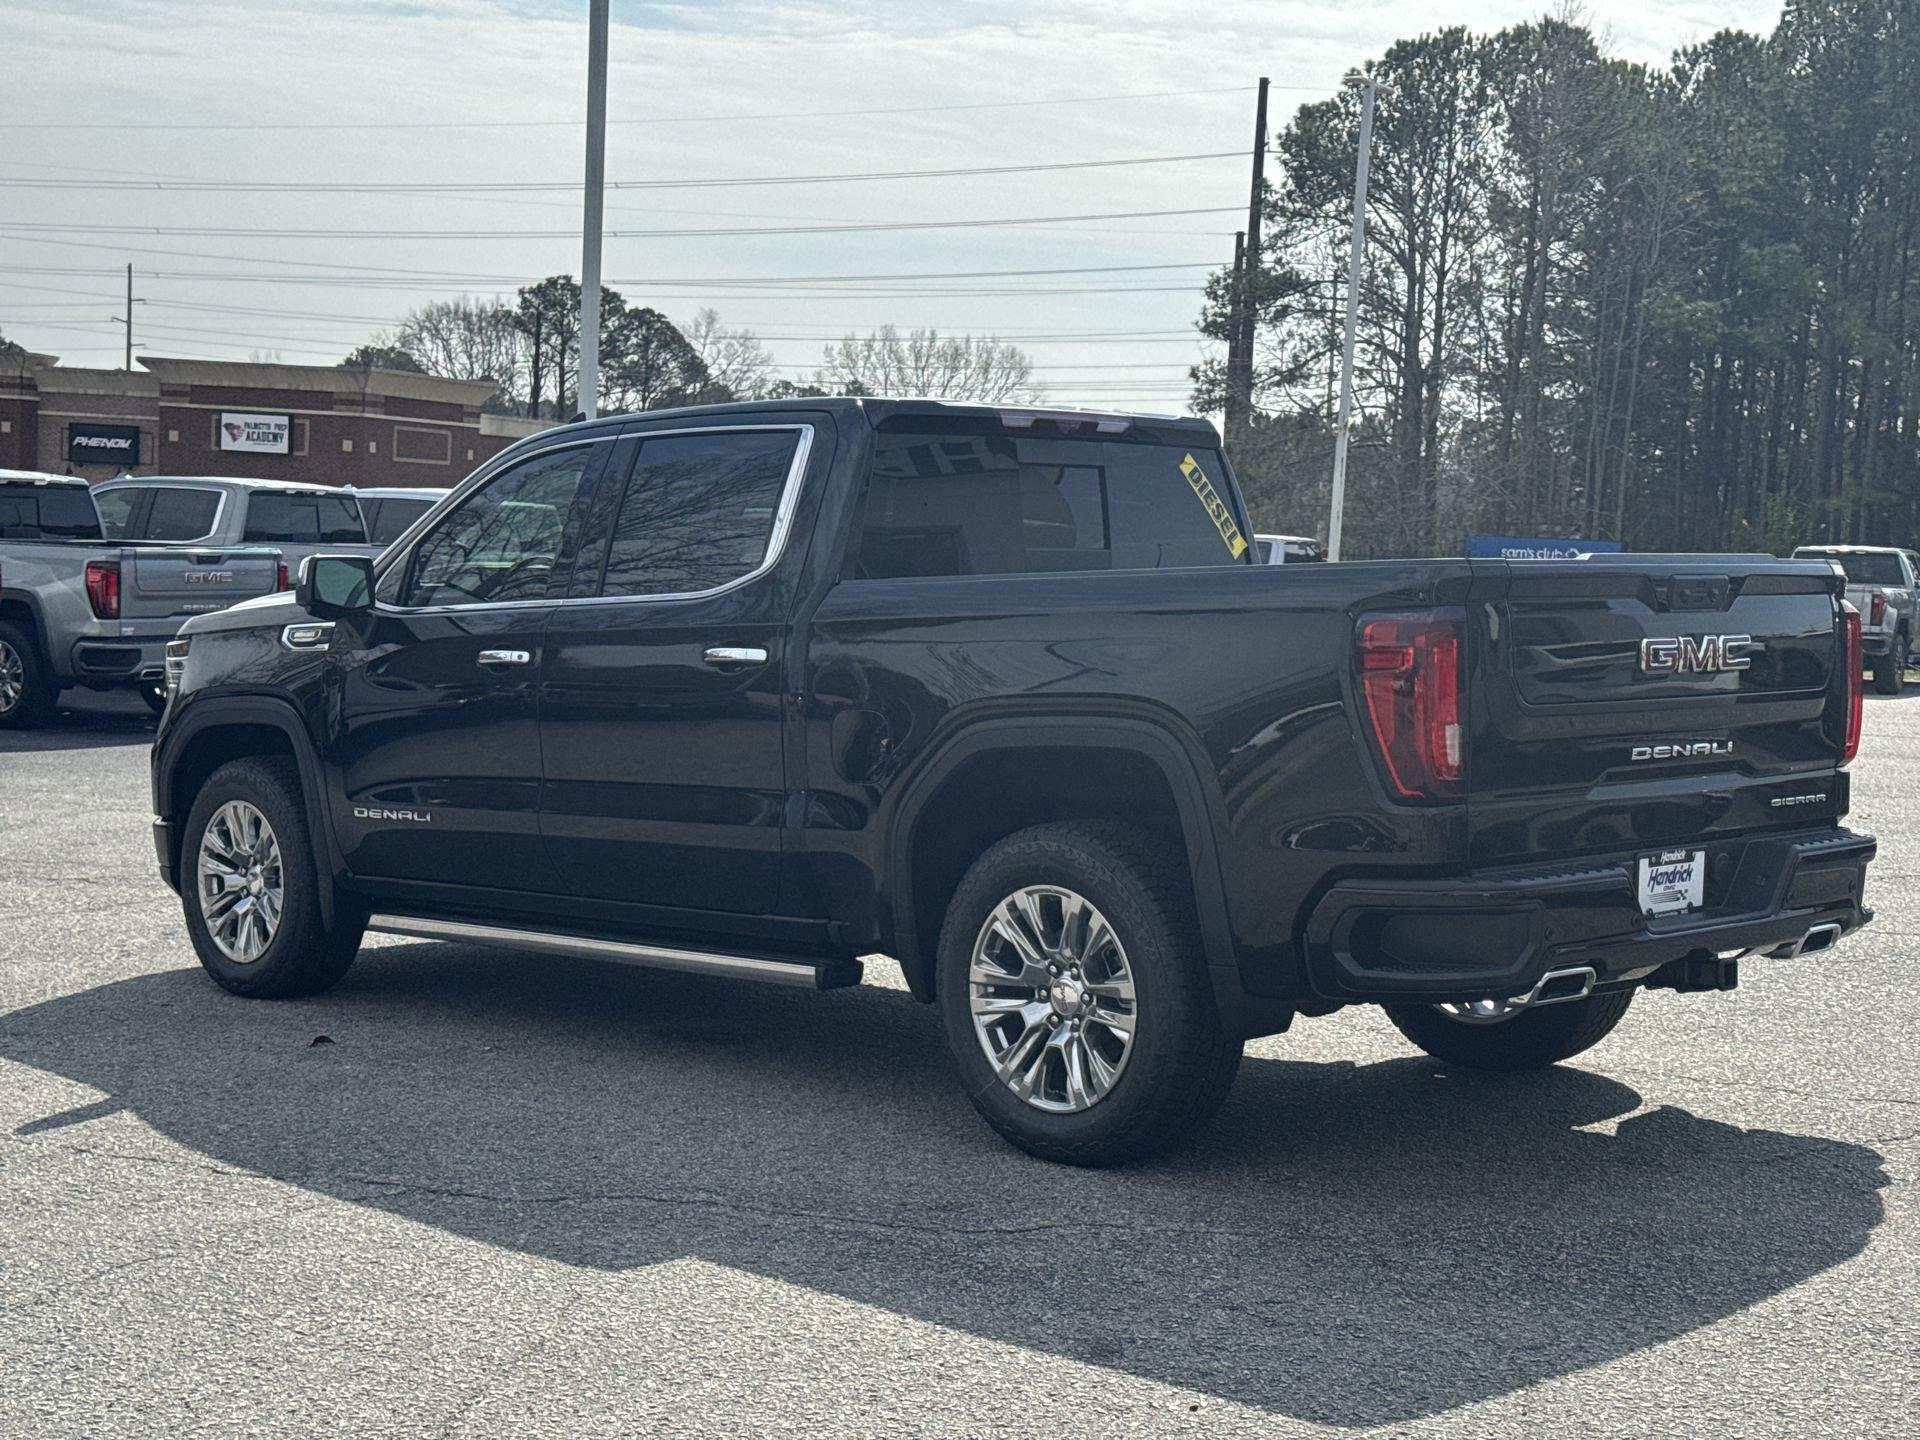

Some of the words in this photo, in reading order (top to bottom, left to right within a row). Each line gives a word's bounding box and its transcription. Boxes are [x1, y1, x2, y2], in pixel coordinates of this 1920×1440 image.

[72, 435, 132, 450] PHENOM
[245, 430, 285, 443] ACADEMY
[1187, 462, 1242, 547] DIESEL
[1500, 547, 1535, 559] sam's
[1536, 547, 1564, 560] club
[184, 571, 233, 584] GMC
[1640, 633, 1752, 675] GMC
[1631, 740, 1734, 761] DENALI
[1770, 793, 1827, 808] SIERRA
[353, 807, 431, 822] DENALI
[1647, 864, 1694, 893] Hendrick
